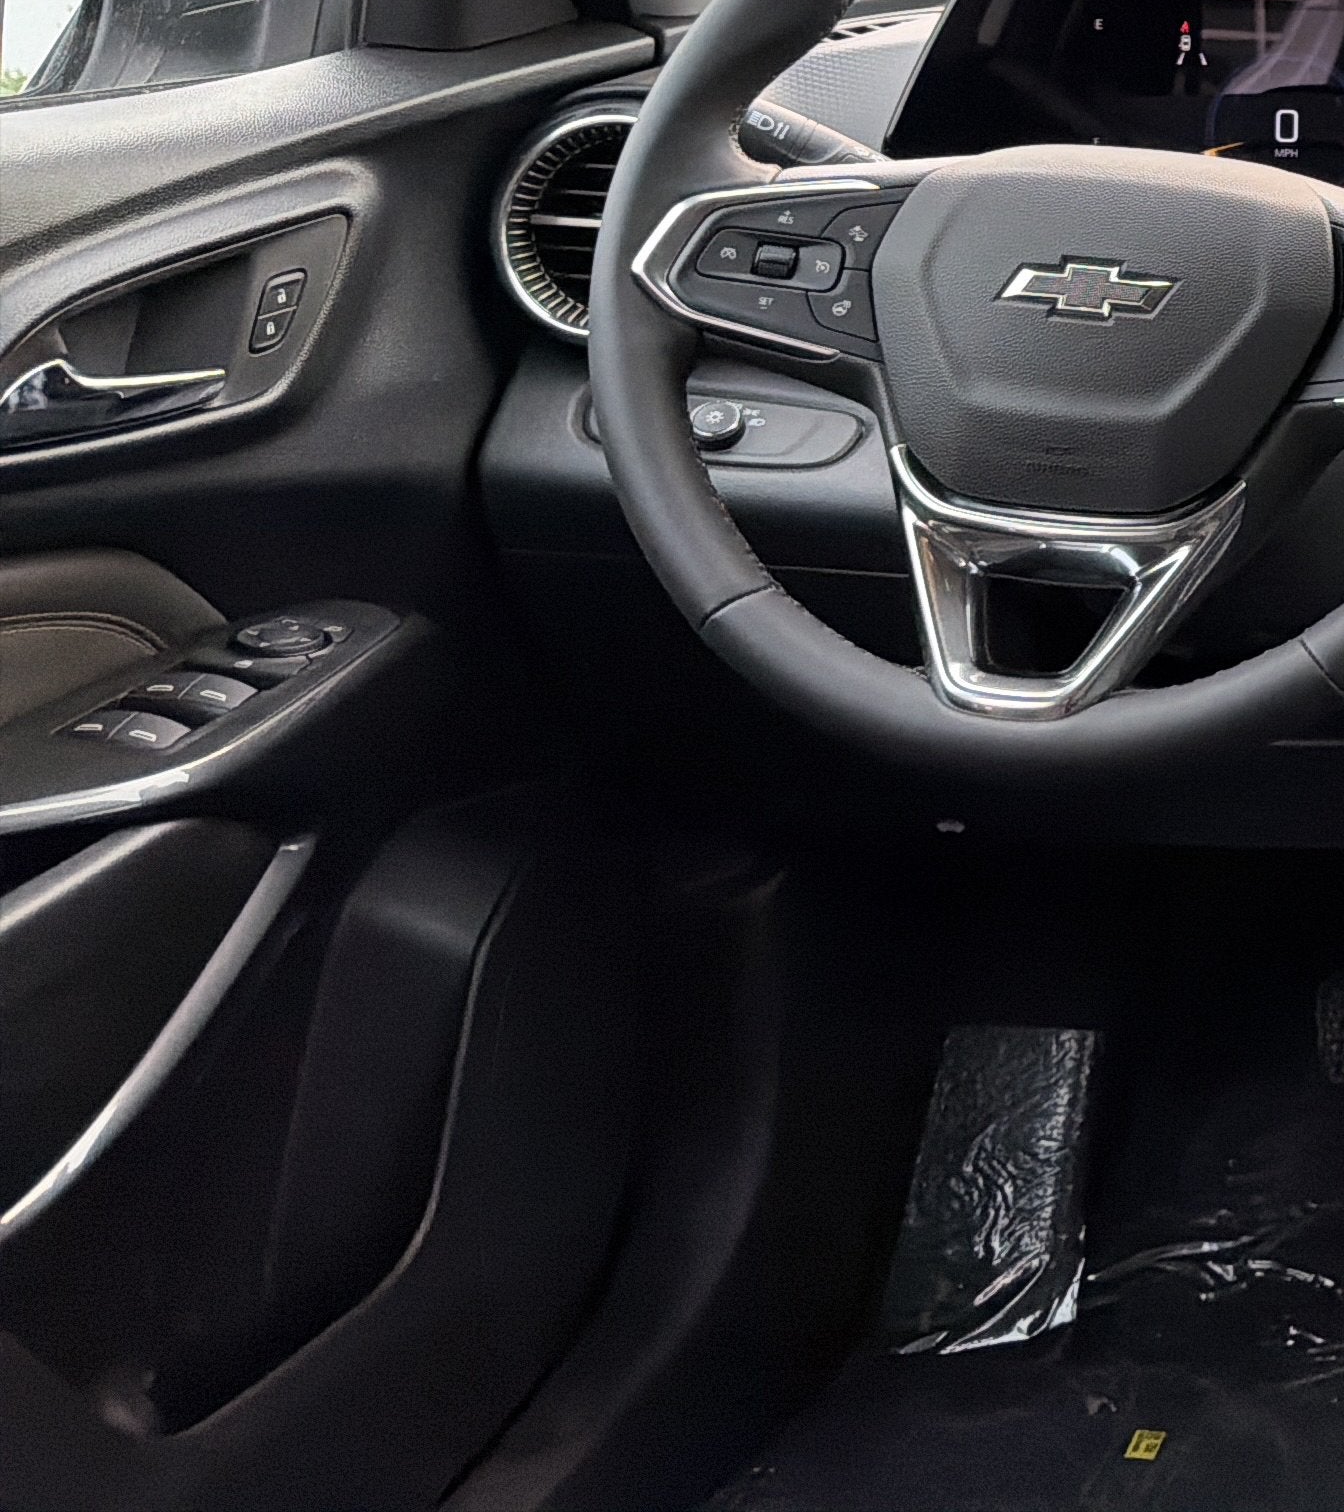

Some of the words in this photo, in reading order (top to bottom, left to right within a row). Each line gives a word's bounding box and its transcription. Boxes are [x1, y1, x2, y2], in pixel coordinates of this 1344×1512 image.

[1094, 19, 1103, 30] E
[1275, 109, 1299, 143] 0
[1274, 148, 1299, 159] MPH
[758, 296, 774, 306] SET
